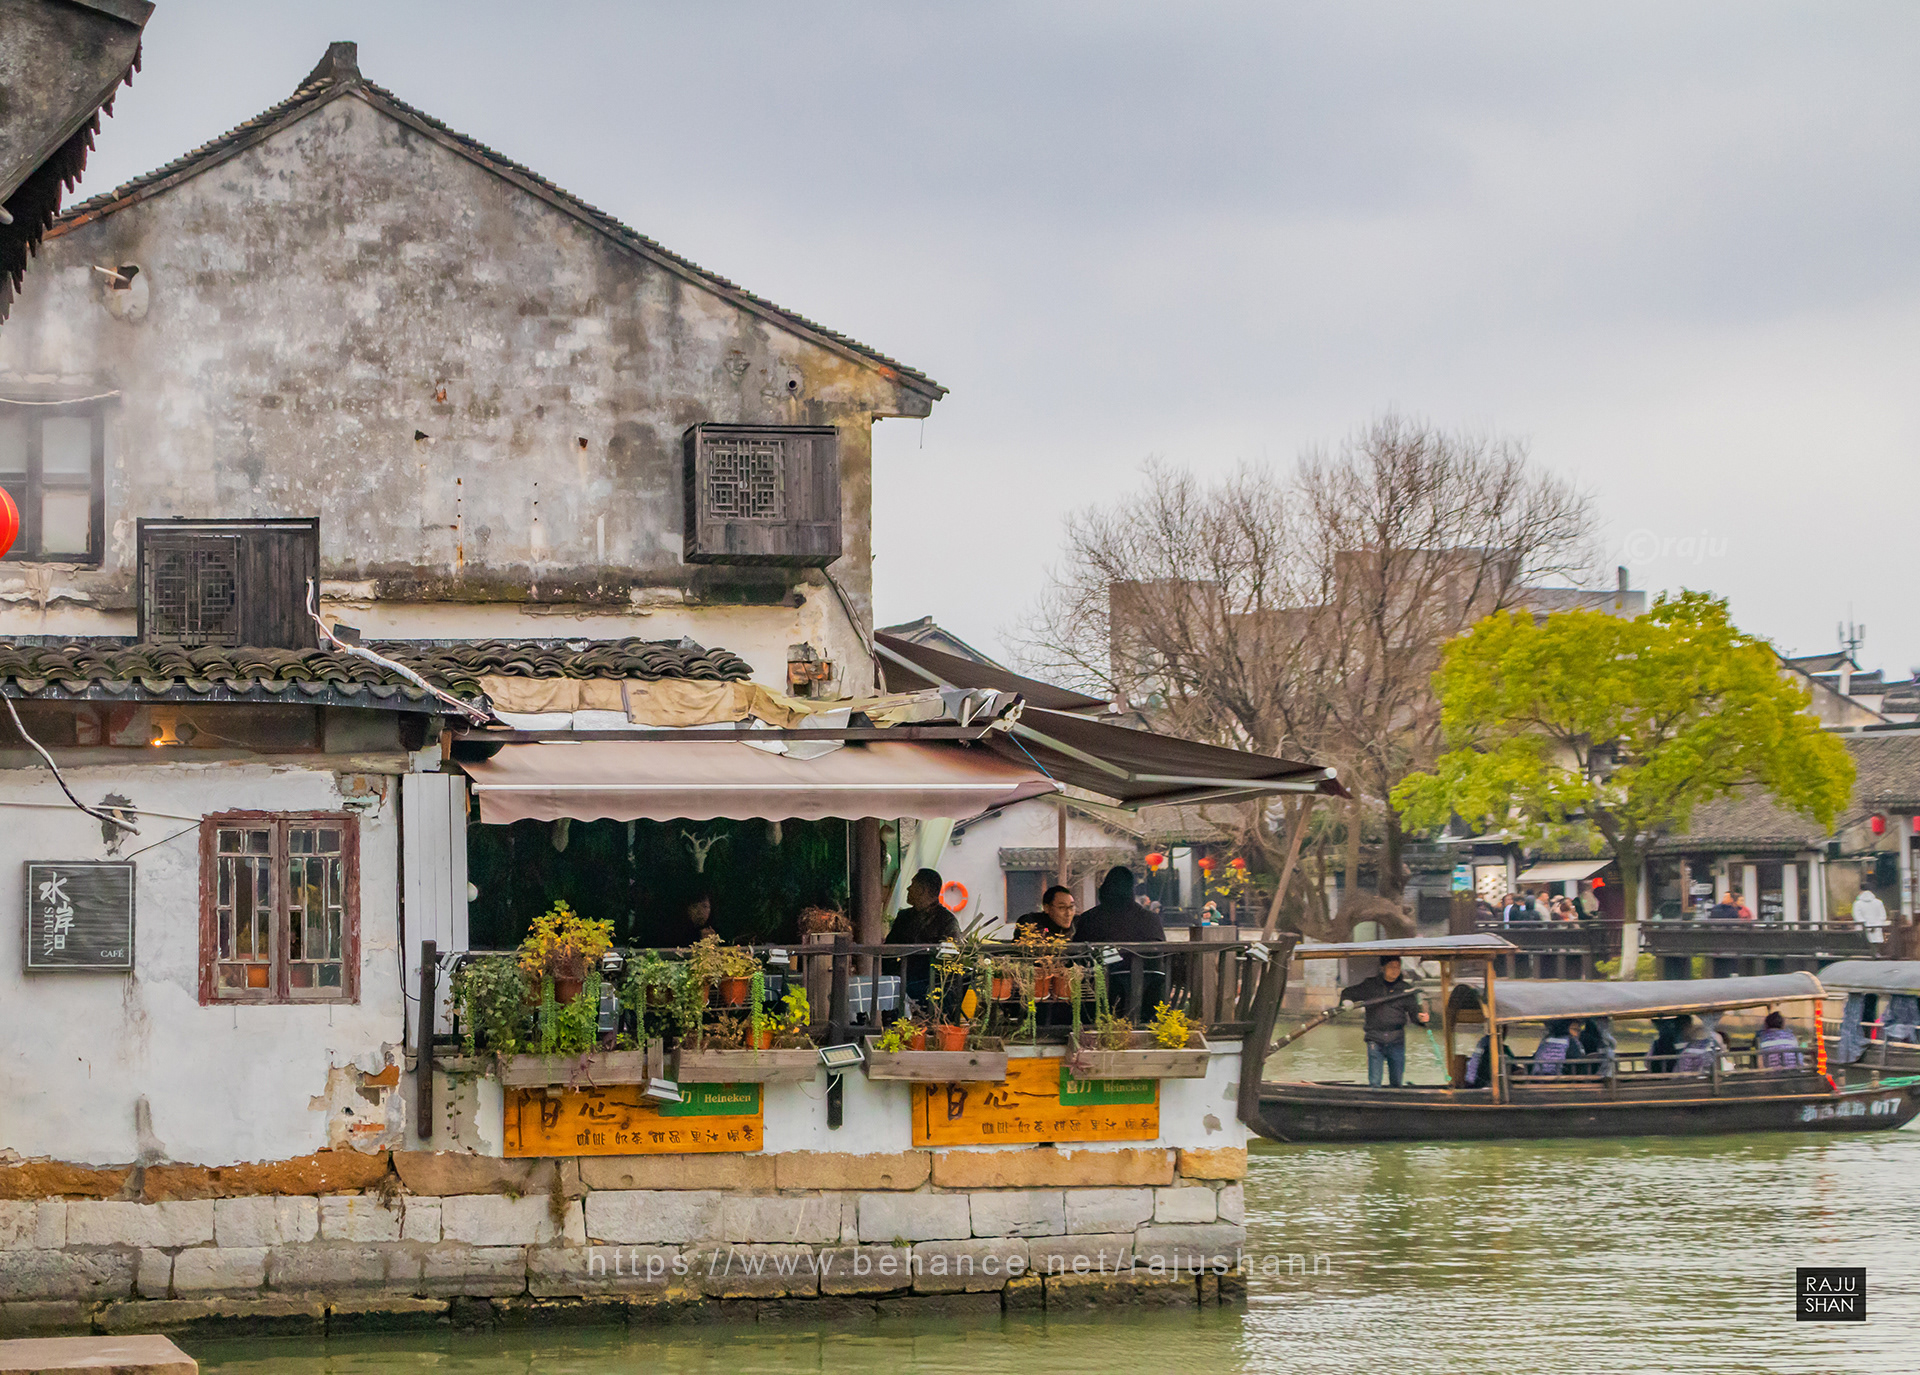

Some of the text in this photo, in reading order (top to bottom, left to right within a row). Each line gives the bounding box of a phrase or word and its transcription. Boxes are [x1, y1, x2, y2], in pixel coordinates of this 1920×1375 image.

[39, 871, 75, 935] 水岸
[43, 906, 54, 956] SHUIAN
[100, 948, 124, 958] CAFÉ
[704, 1093, 752, 1103] Heineken
